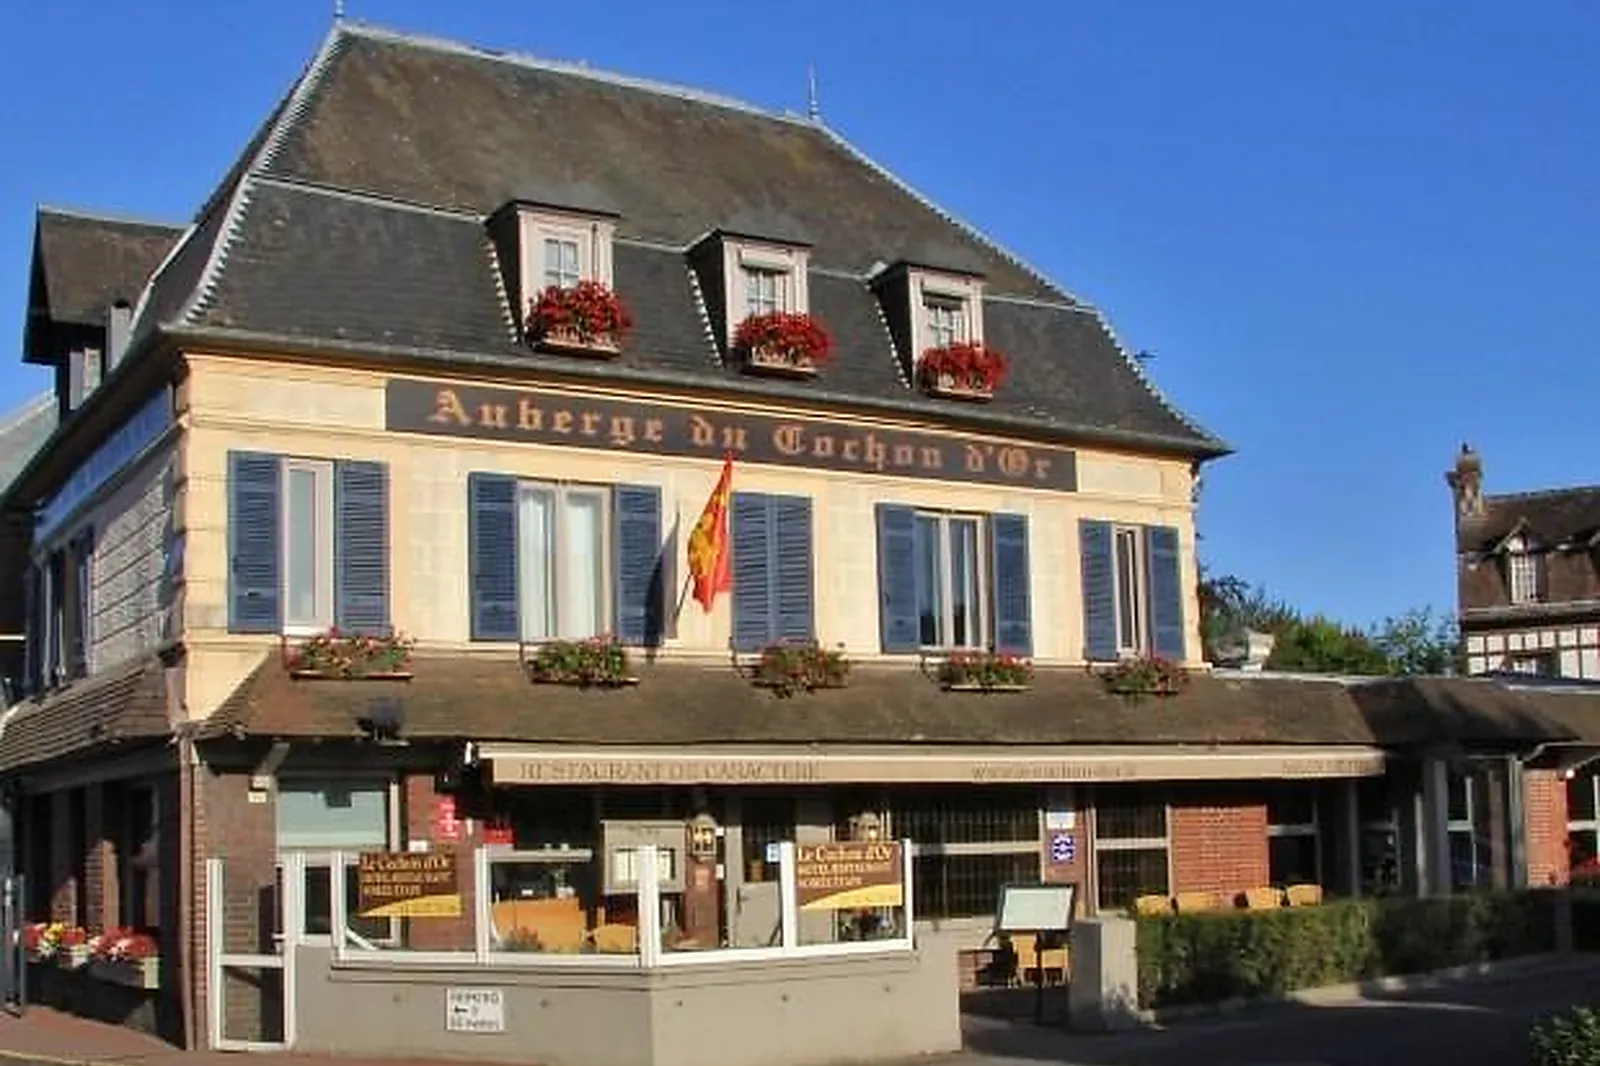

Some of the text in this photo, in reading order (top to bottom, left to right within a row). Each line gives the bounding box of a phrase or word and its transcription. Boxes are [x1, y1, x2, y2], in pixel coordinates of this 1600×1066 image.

[428, 389, 1053, 480] Auberge du Cochon d'Or
